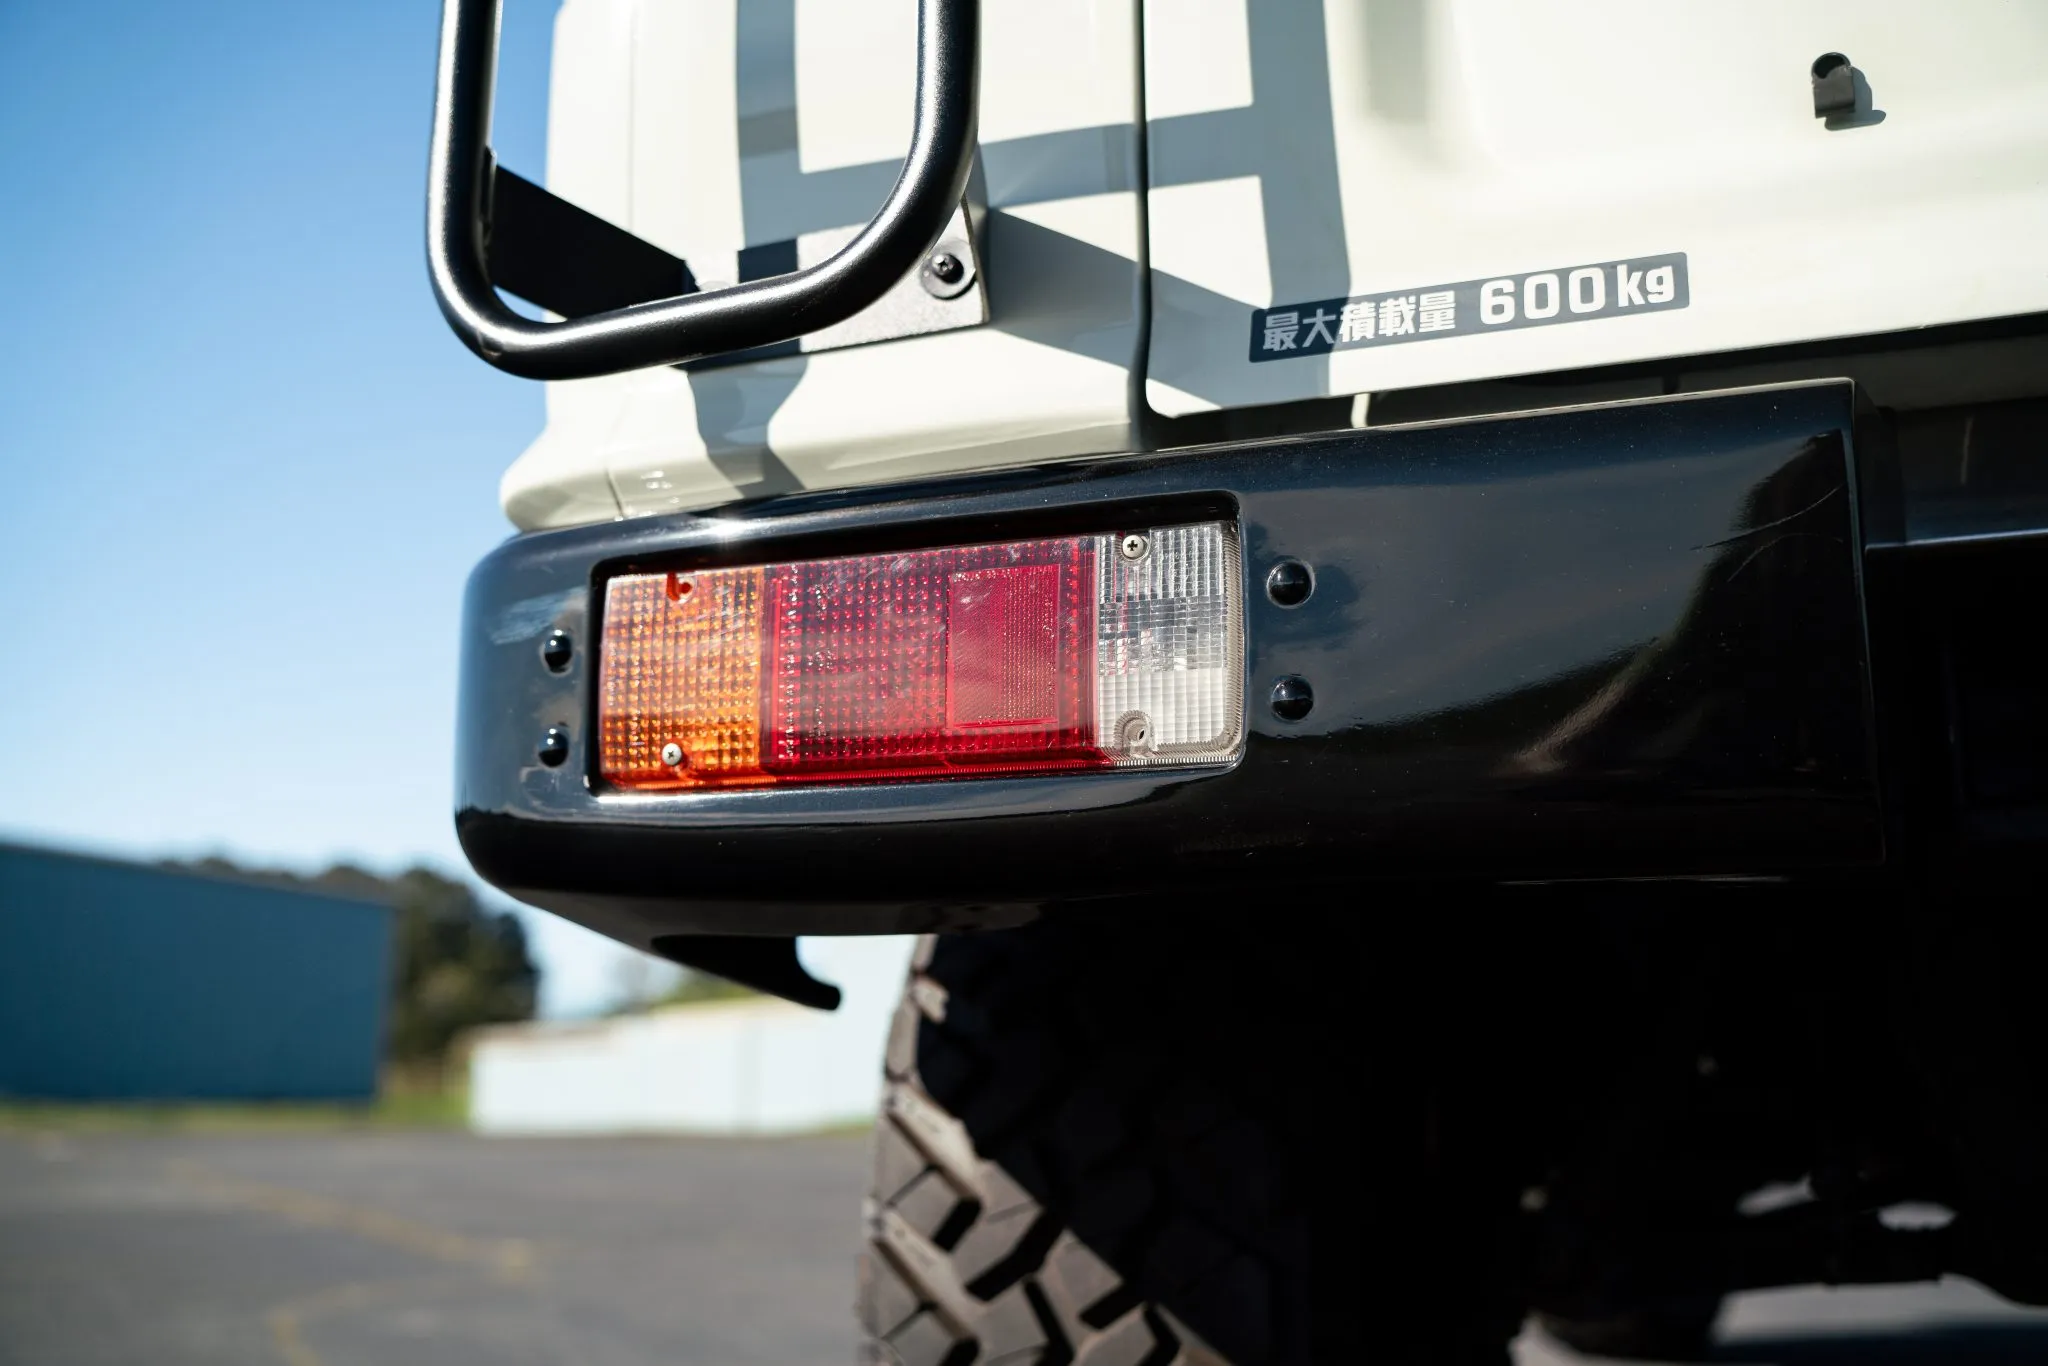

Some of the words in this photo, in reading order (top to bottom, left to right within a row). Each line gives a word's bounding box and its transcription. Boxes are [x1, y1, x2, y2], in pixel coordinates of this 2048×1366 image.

[1262, 291, 1456, 351] 最大積載量
